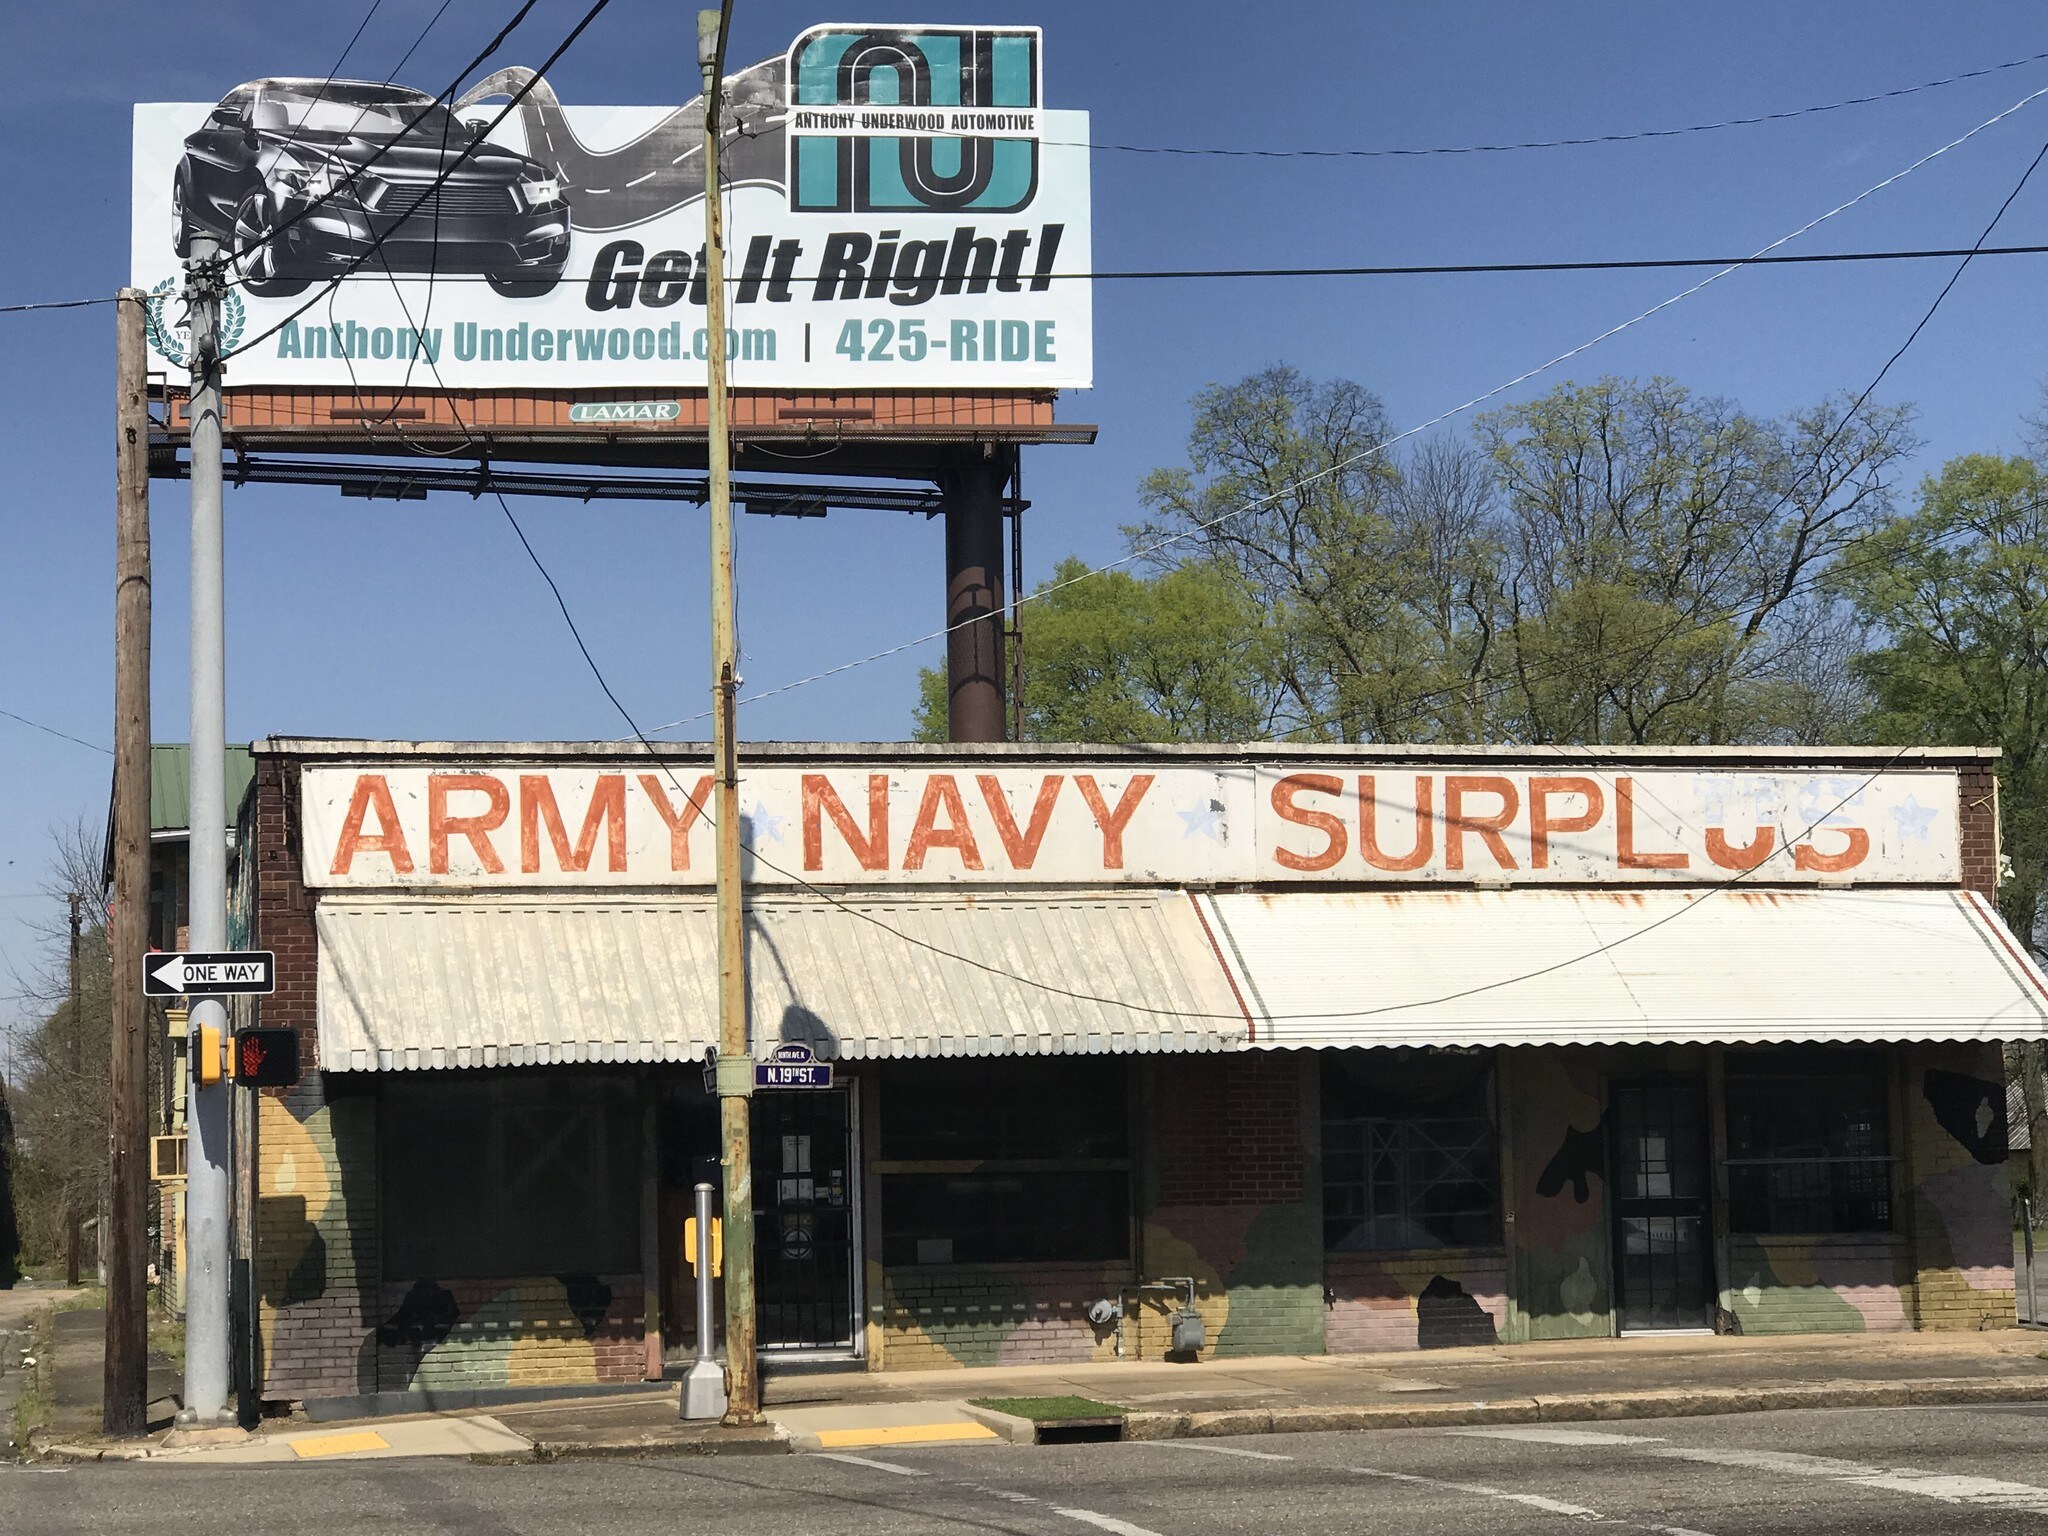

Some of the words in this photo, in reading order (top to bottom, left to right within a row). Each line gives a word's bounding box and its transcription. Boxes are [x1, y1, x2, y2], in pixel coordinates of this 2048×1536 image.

[795, 112, 855, 129] ANTHONY
[862, 113, 944, 130] UNDERWOOD
[951, 114, 1034, 130] AUTOMOTIVE
[735, 235, 803, 304] It
[812, 223, 1065, 306] Right!
[277, 319, 443, 364] Anthony
[835, 318, 1056, 362] 425-RIDE
[580, 404, 671, 419] LAMAR
[329, 774, 716, 876] ARMY
[801, 774, 1156, 872] NAVY
[1270, 773, 1870, 872] SURPLUS
[183, 966, 218, 982] ONE
[224, 964, 260, 981] WAY
